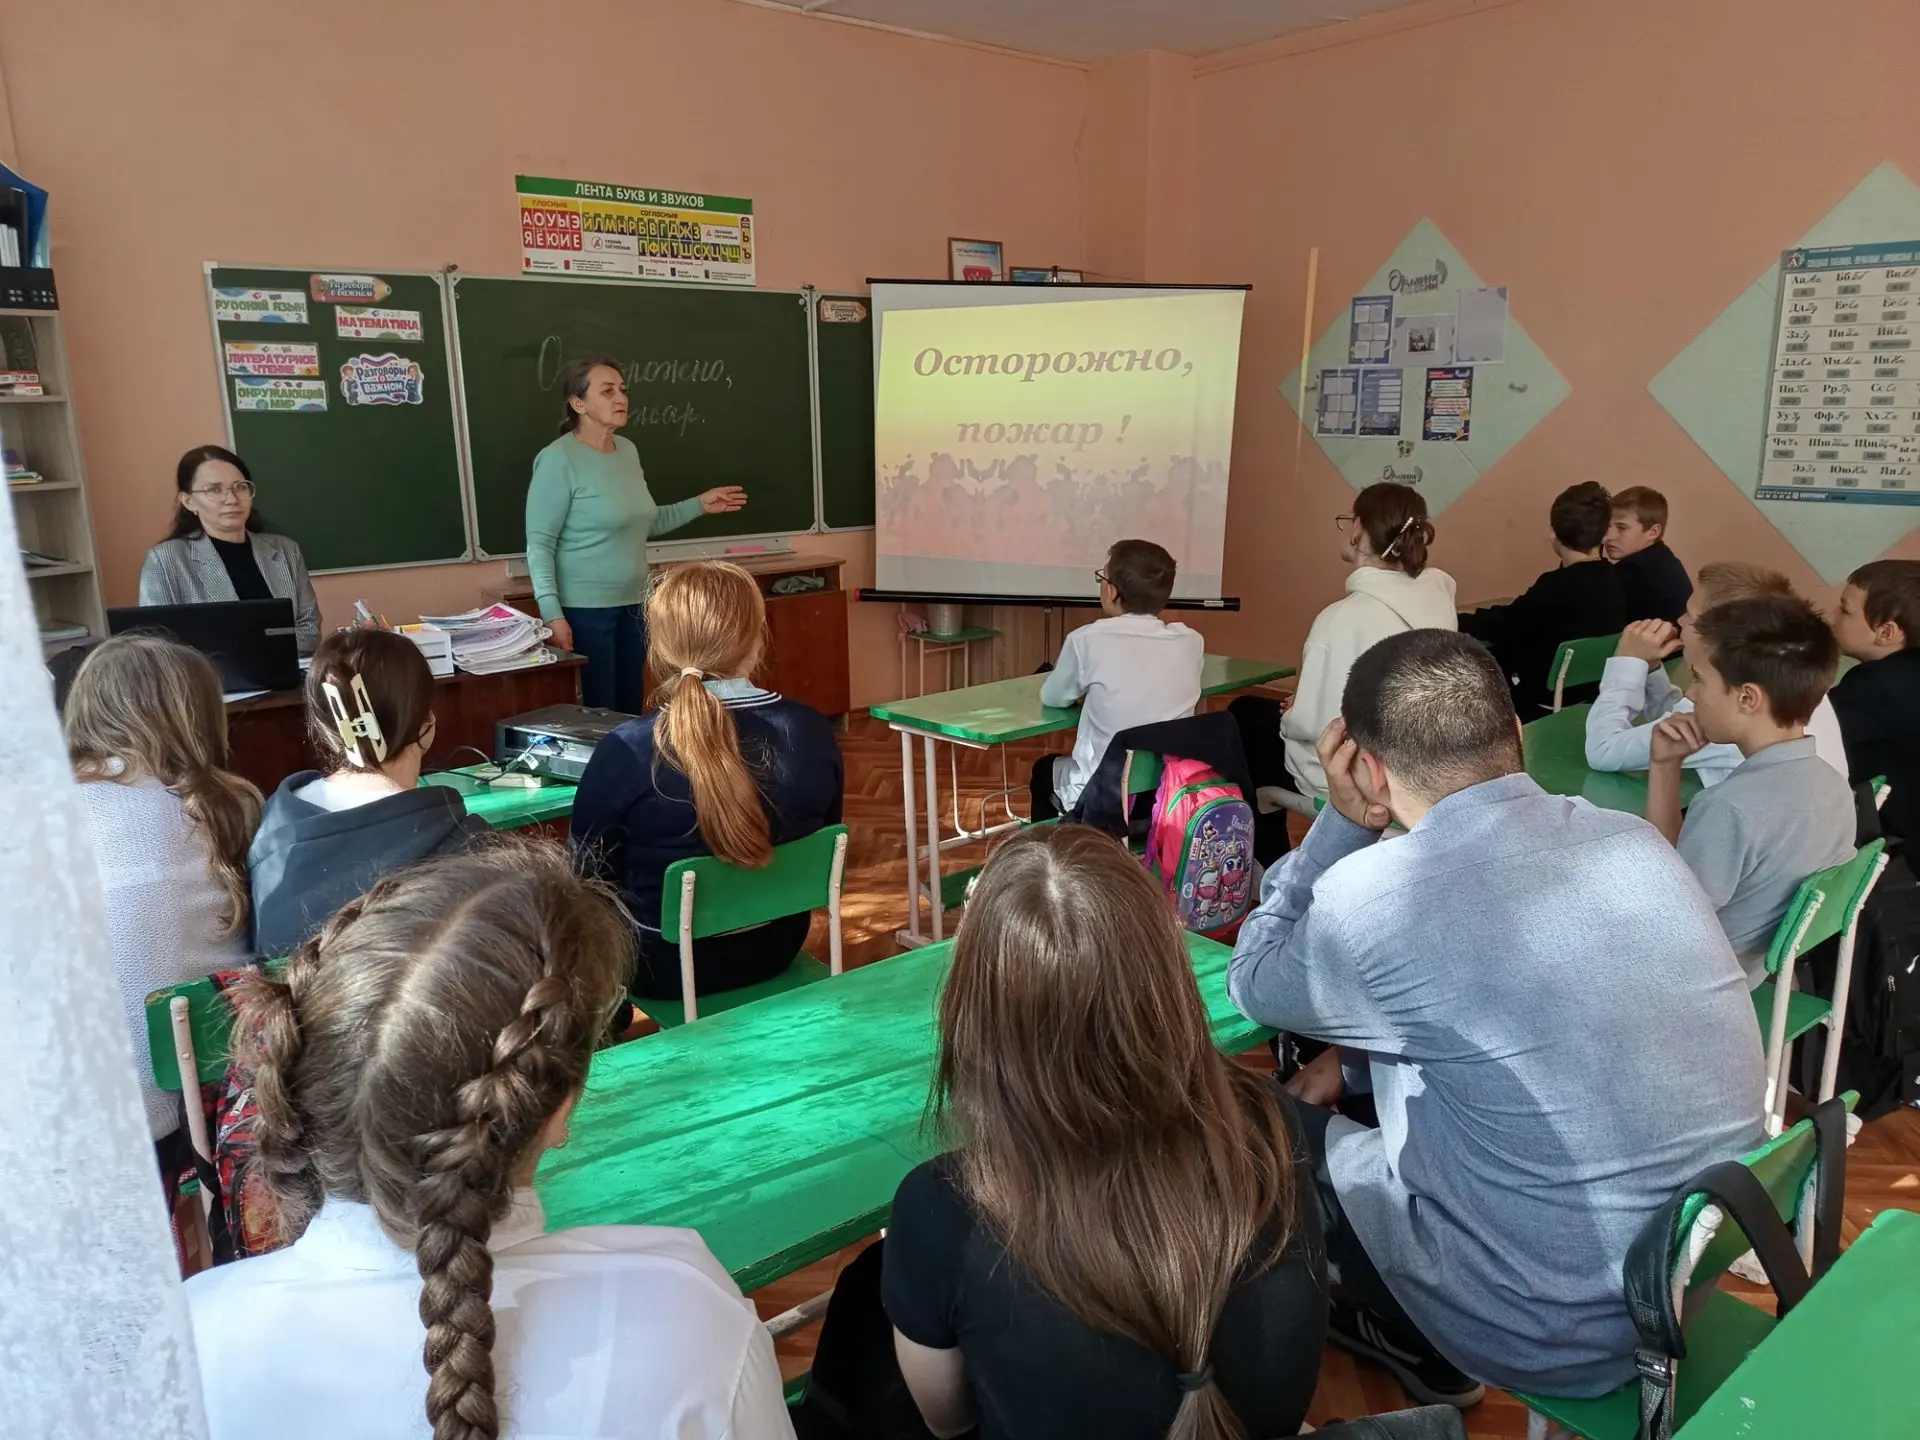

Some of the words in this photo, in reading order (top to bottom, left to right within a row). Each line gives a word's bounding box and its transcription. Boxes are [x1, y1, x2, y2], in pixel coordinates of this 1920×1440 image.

[575, 183, 614, 198] ЛЕНТА
[616, 187, 646, 202] БУКВ
[649, 191, 658, 203] И
[661, 193, 705, 208] ЗВУКОВ
[640, 210, 679, 219] согласные
[215, 298, 269, 312] РУССКИЙ
[273, 301, 306, 313] ЯЗЫК
[337, 316, 420, 330] МАТЕМАТИКА
[228, 353, 317, 365] ЛИТЕРАТУРНОЕ
[914, 345, 1194, 383] Осторожно,
[253, 364, 296, 374] ЧТЕНИЕ
[356, 366, 407, 381] Разговоры
[237, 387, 324, 400] ОКРУЖАЮЩИЙ
[363, 382, 404, 393] важном
[270, 399, 296, 409] МИР
[956, 418, 1104, 452] пожар
